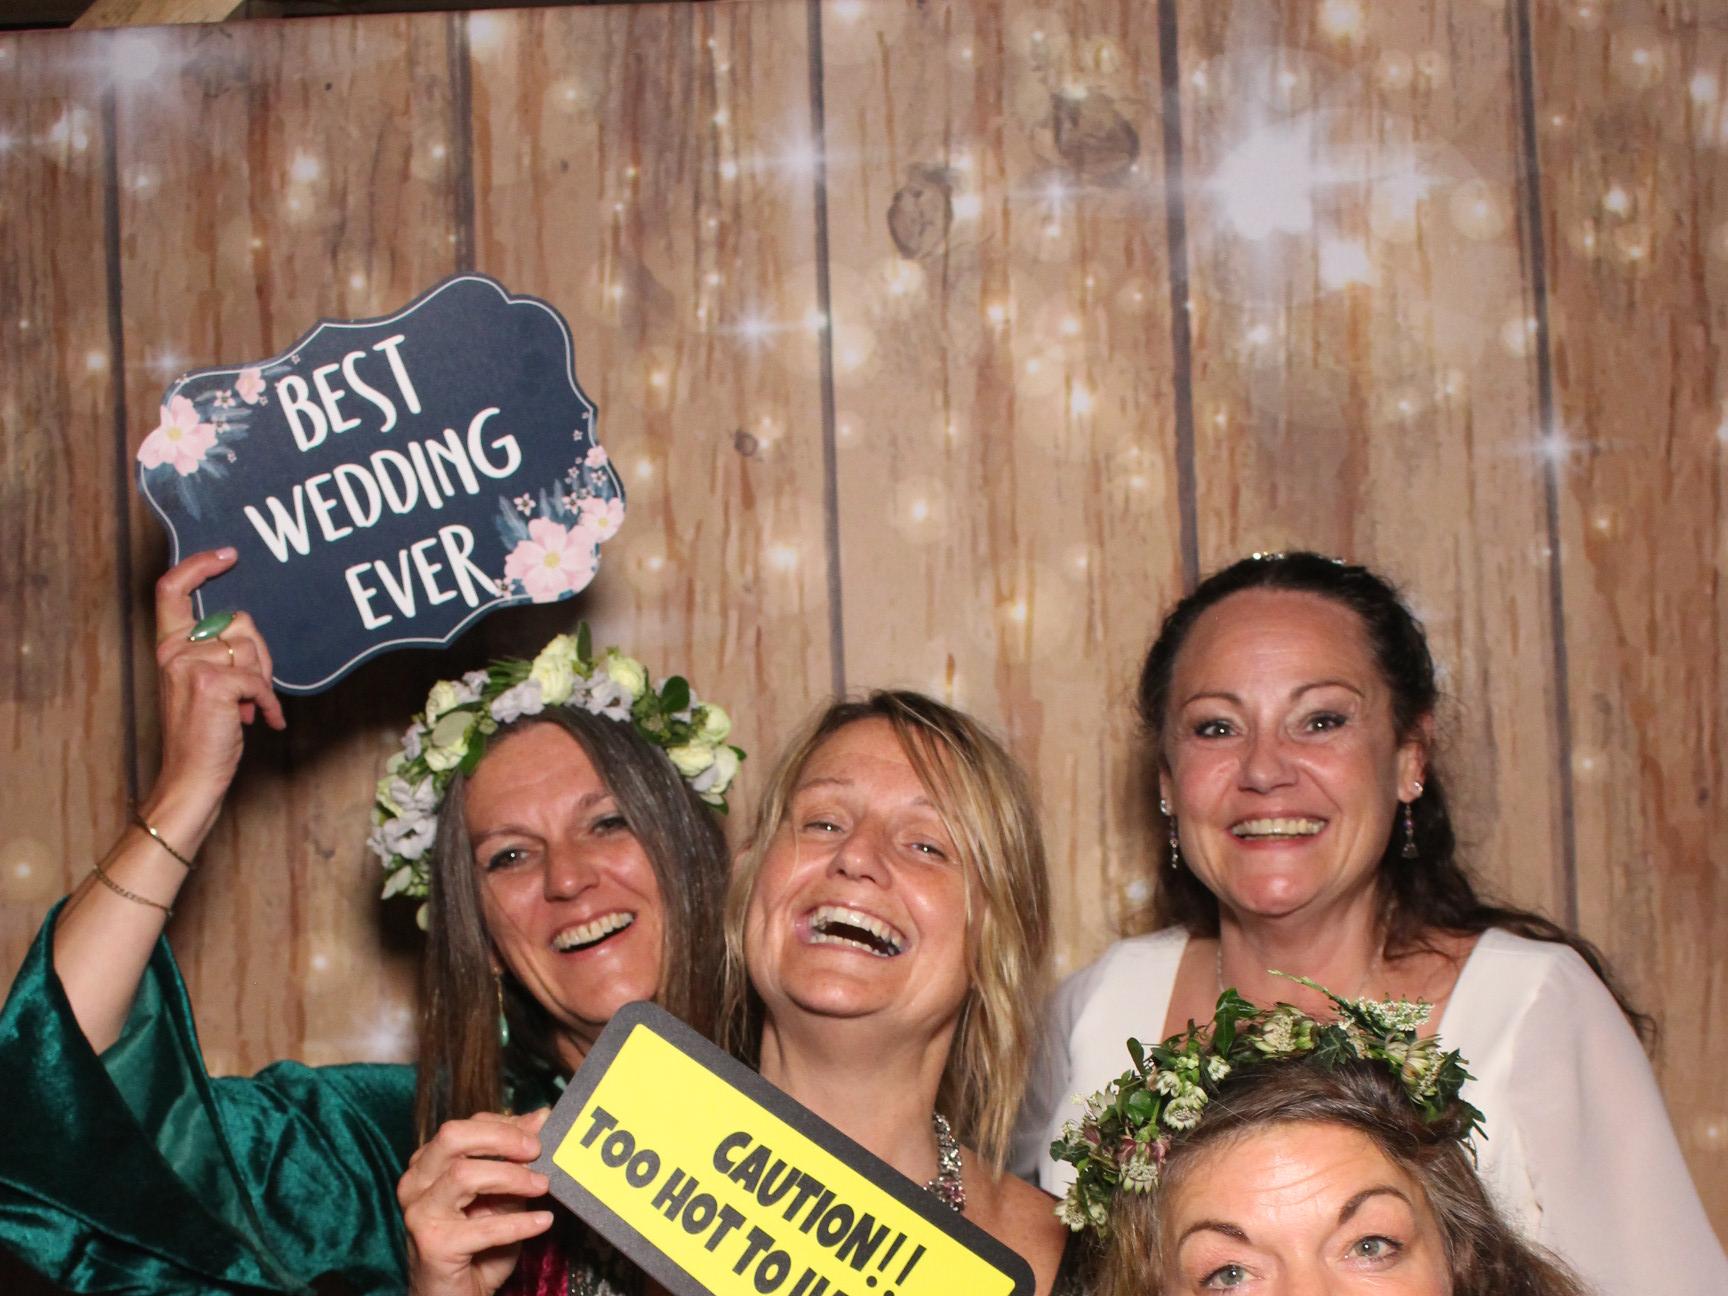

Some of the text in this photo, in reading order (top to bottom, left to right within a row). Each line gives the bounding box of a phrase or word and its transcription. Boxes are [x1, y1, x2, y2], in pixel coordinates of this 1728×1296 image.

[277, 334, 421, 452] BEST
[244, 407, 522, 563] WEDDING
[345, 524, 500, 630] EVER
[579, 1106, 661, 1188] TOO
[652, 1170, 744, 1252] HOT
[732, 1225, 791, 1295] TO
